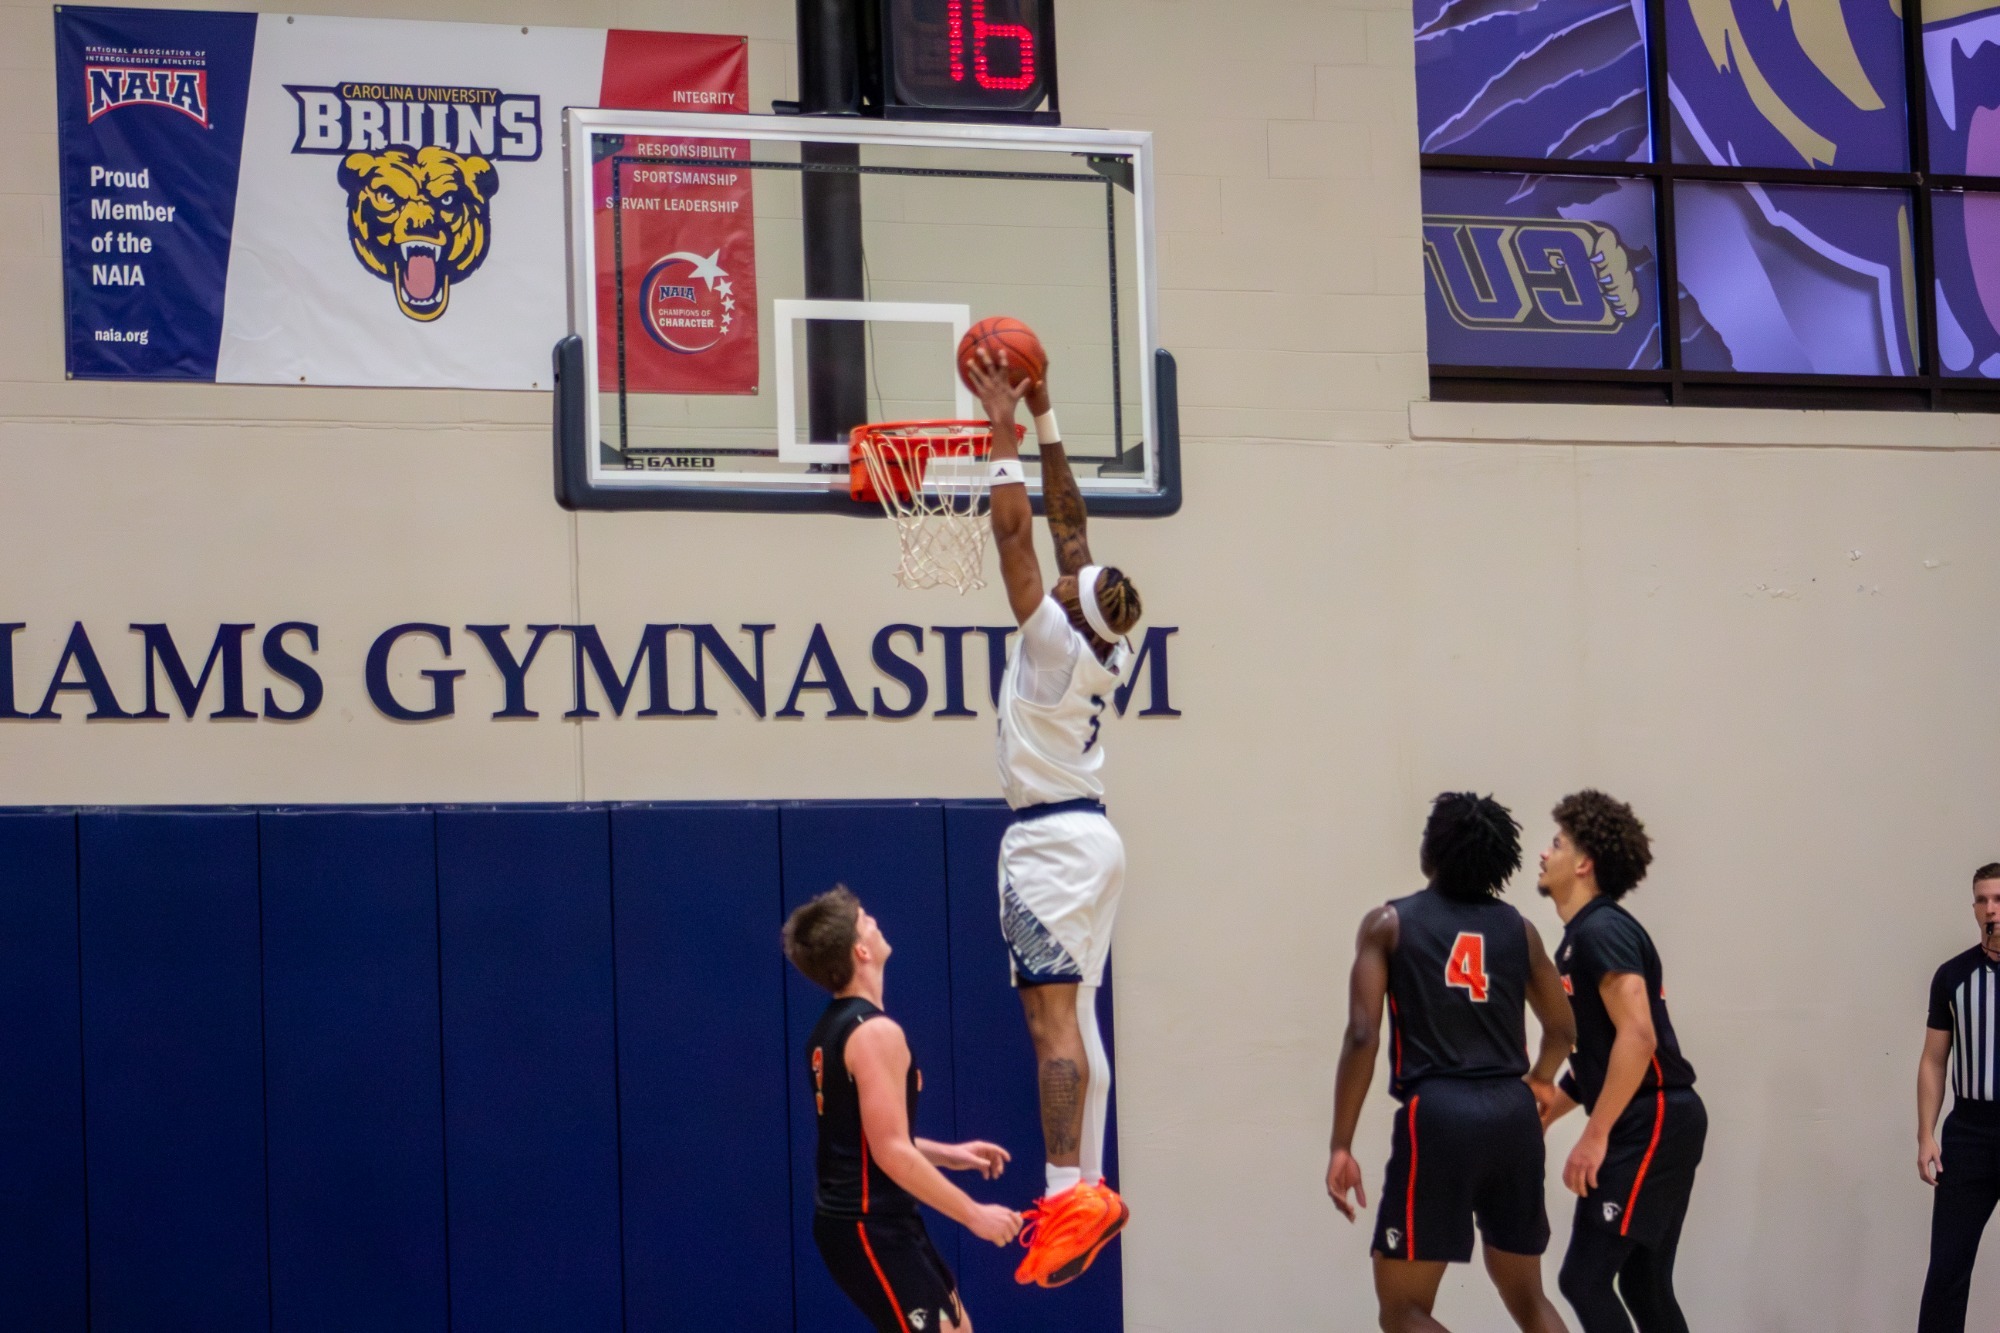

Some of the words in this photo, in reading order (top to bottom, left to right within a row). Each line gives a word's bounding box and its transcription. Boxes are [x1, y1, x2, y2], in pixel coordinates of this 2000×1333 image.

[86, 46, 128, 54] NATIONAL
[132, 48, 191, 57] ASSOCIATION
[86, 55, 159, 65] INTERCOLLEGIATE
[162, 58, 206, 66] ATHLETICS
[87, 68, 206, 123] NAIA
[342, 84, 414, 101] CAROLINA
[417, 88, 498, 104] UNIVERSITY
[673, 90, 735, 105] INTEGRITY
[292, 89, 540, 159] BRUINS
[637, 143, 737, 159] RESPONSIBILITY
[90, 166, 150, 189] Proud
[633, 170, 738, 186] SPORTSMANSHIP
[91, 198, 176, 222] Member
[605, 196, 660, 211] SRVANT
[664, 198, 739, 213] LEADERSHIP
[91, 231, 113, 253] of
[117, 232, 152, 253] the
[92, 265, 145, 286] NAIA
[659, 286, 696, 303] NAIA
[658, 309, 700, 317] CHAMPIONS
[701, 309, 712, 317] OF
[658, 318, 714, 328] CHARACTER
[95, 328, 149, 345] naia.org
[647, 456, 716, 468] GARED
[1445, 931, 1489, 1003] 4
